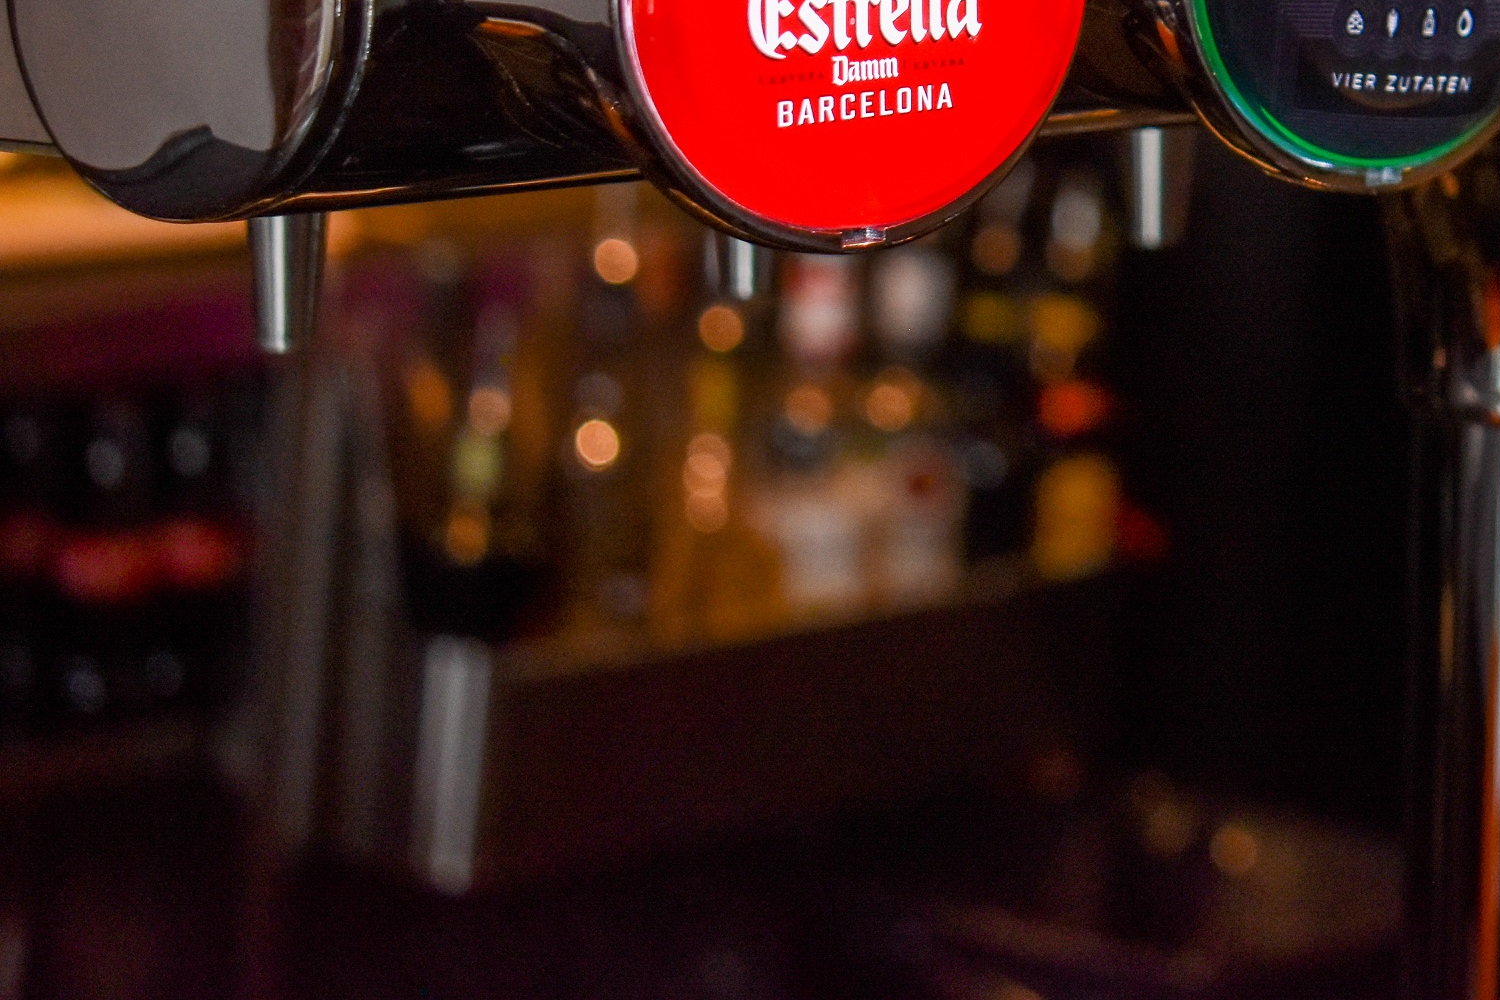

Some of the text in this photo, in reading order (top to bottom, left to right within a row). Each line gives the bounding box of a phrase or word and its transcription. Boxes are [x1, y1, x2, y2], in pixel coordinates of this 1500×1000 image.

[831, 55, 899, 87] Damm
[1331, 71, 1473, 94] VIER ZUTATEN
[776, 82, 954, 129] BARCELONA
